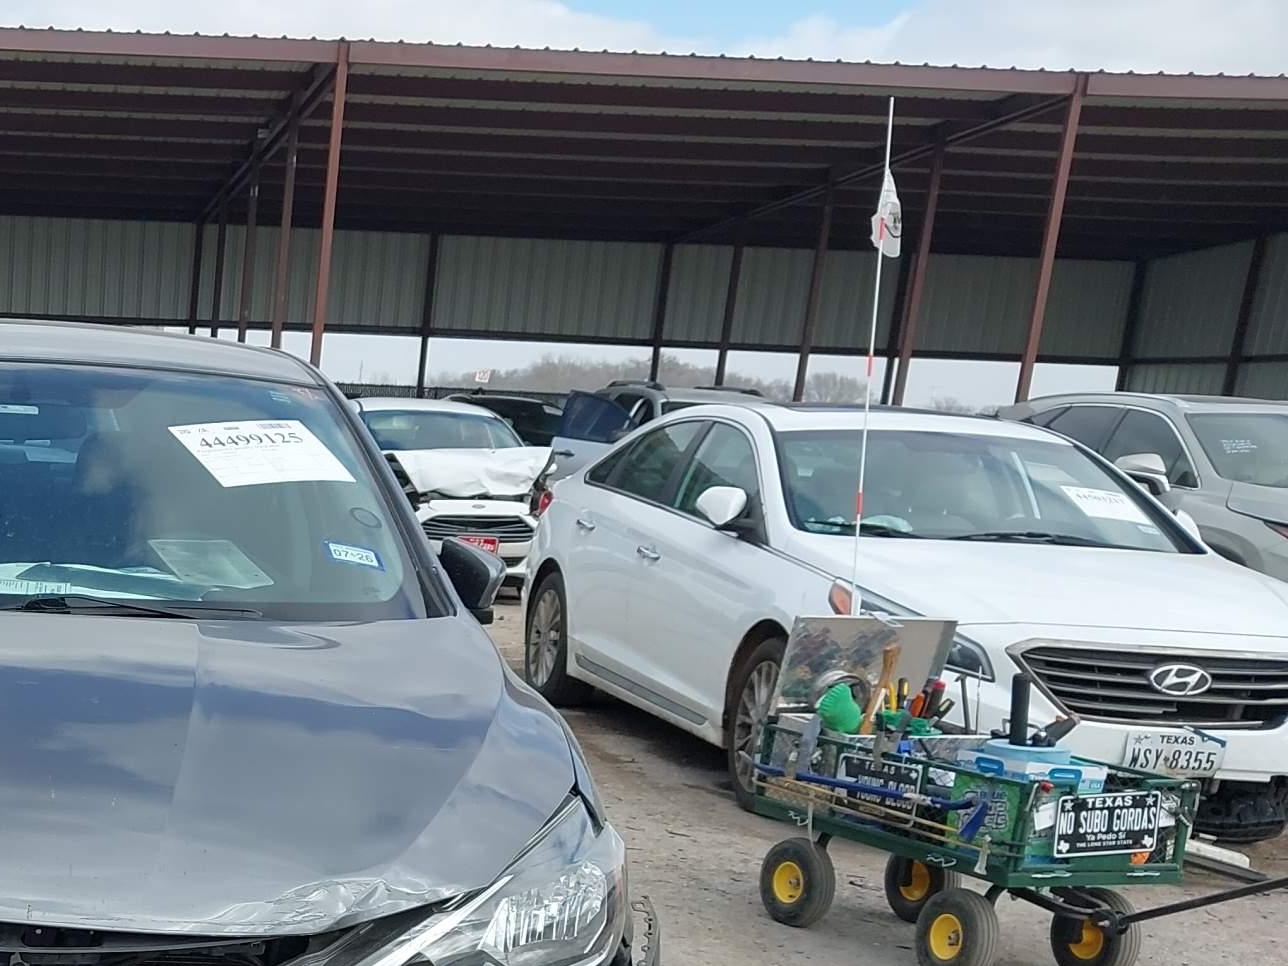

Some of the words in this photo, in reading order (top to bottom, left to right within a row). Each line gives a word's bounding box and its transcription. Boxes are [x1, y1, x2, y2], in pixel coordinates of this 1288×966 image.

[199, 432, 303, 449] 44499125
[1160, 735, 1195, 745] TEXAS
[1128, 747, 1163, 770] WSY
[1169, 749, 1217, 771] 8355
[865, 761, 896, 775] TEAS
[1087, 796, 1132, 808] TEXAS
[1059, 812, 1075, 834] NO
[1079, 809, 1109, 833] SUBO
[1113, 808, 1156, 831] GORDAS
[1097, 832, 1117, 840] Pedo
